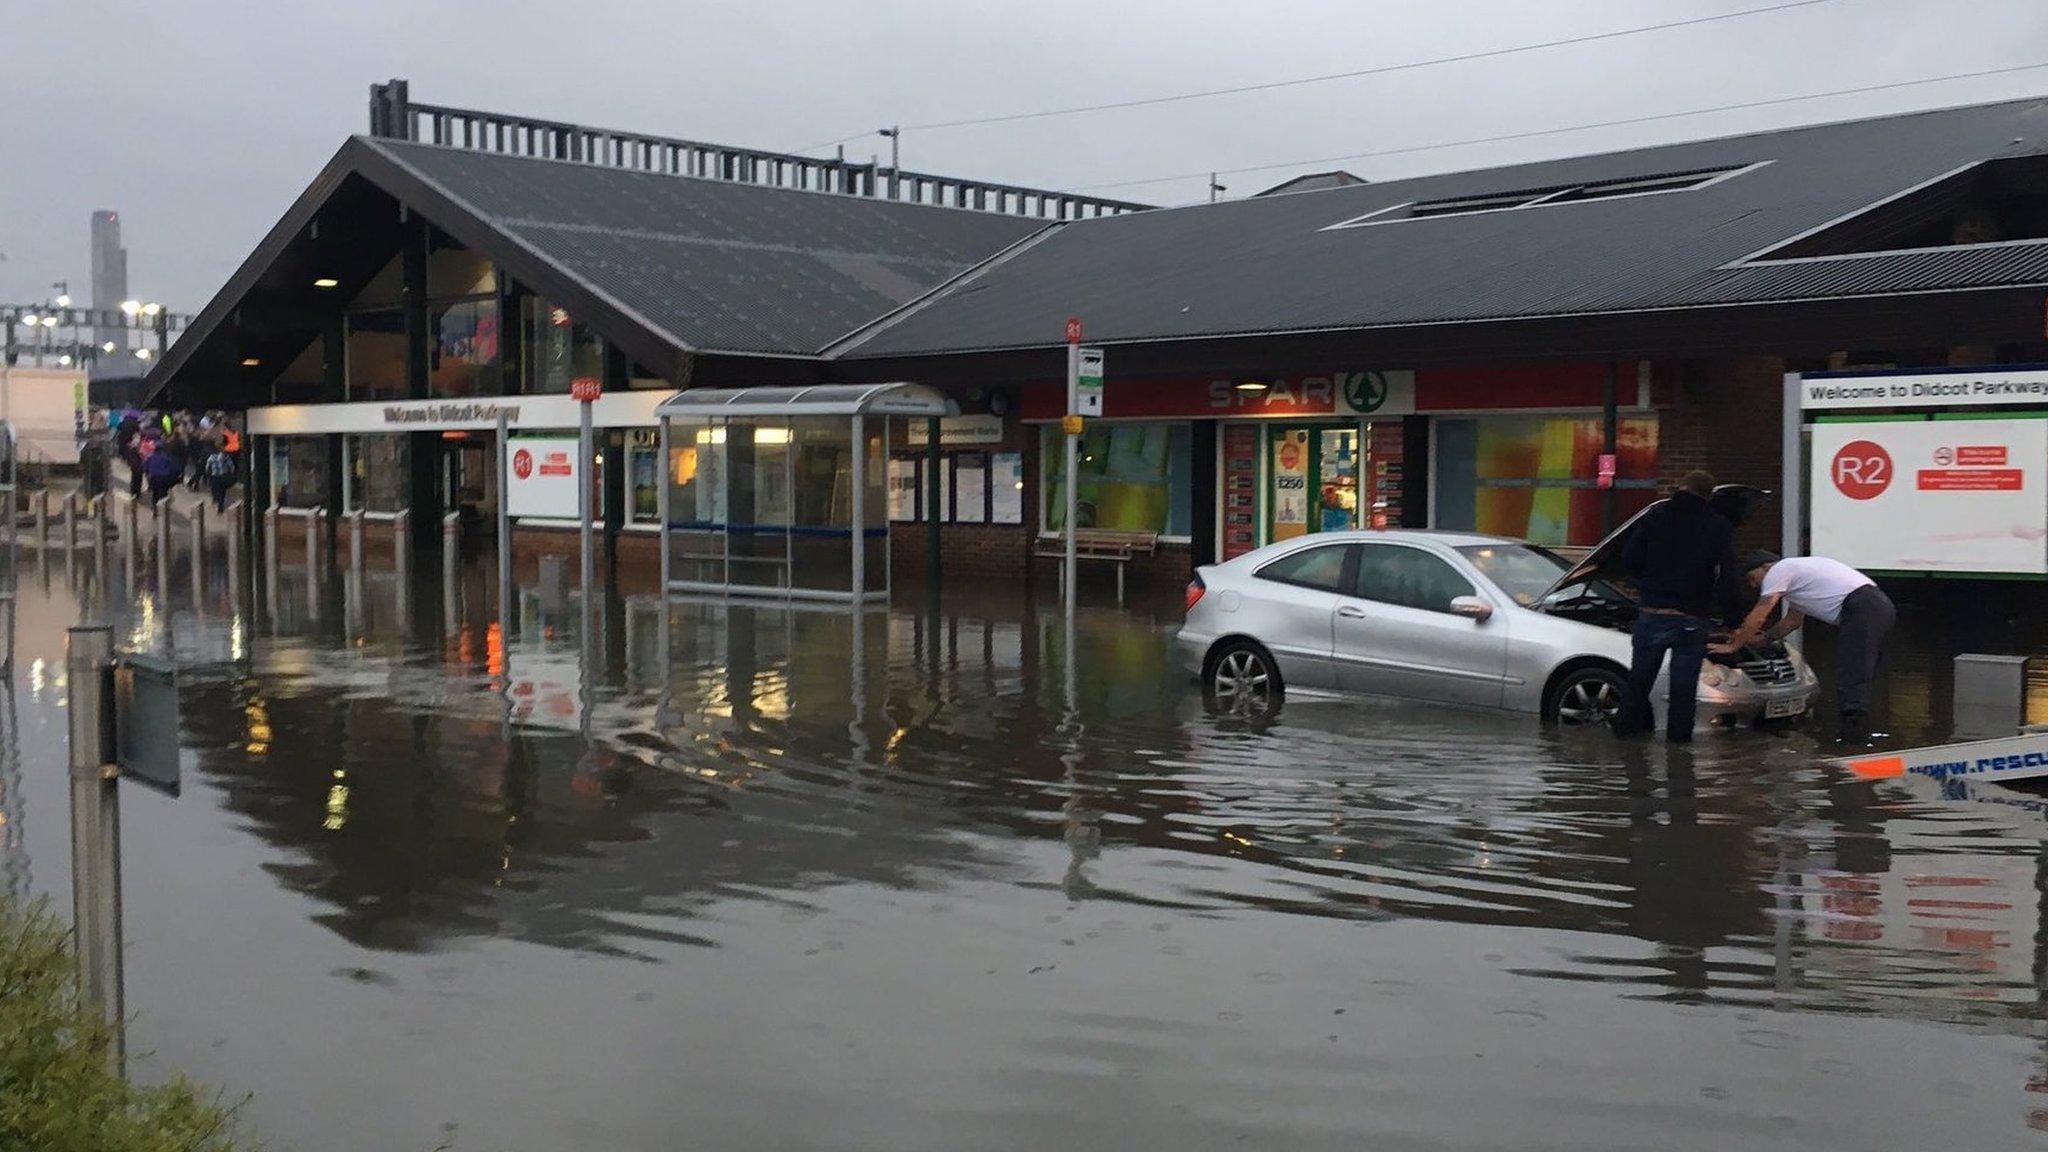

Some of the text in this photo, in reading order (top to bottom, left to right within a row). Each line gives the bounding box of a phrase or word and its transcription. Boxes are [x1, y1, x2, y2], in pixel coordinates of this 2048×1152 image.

[1209, 376, 1333, 408] SPAR
[1808, 385, 1887, 400] Welcome
[1890, 383, 1909, 398] to
[1911, 381, 1970, 397] Didcot
[1837, 456, 1887, 485] R2
